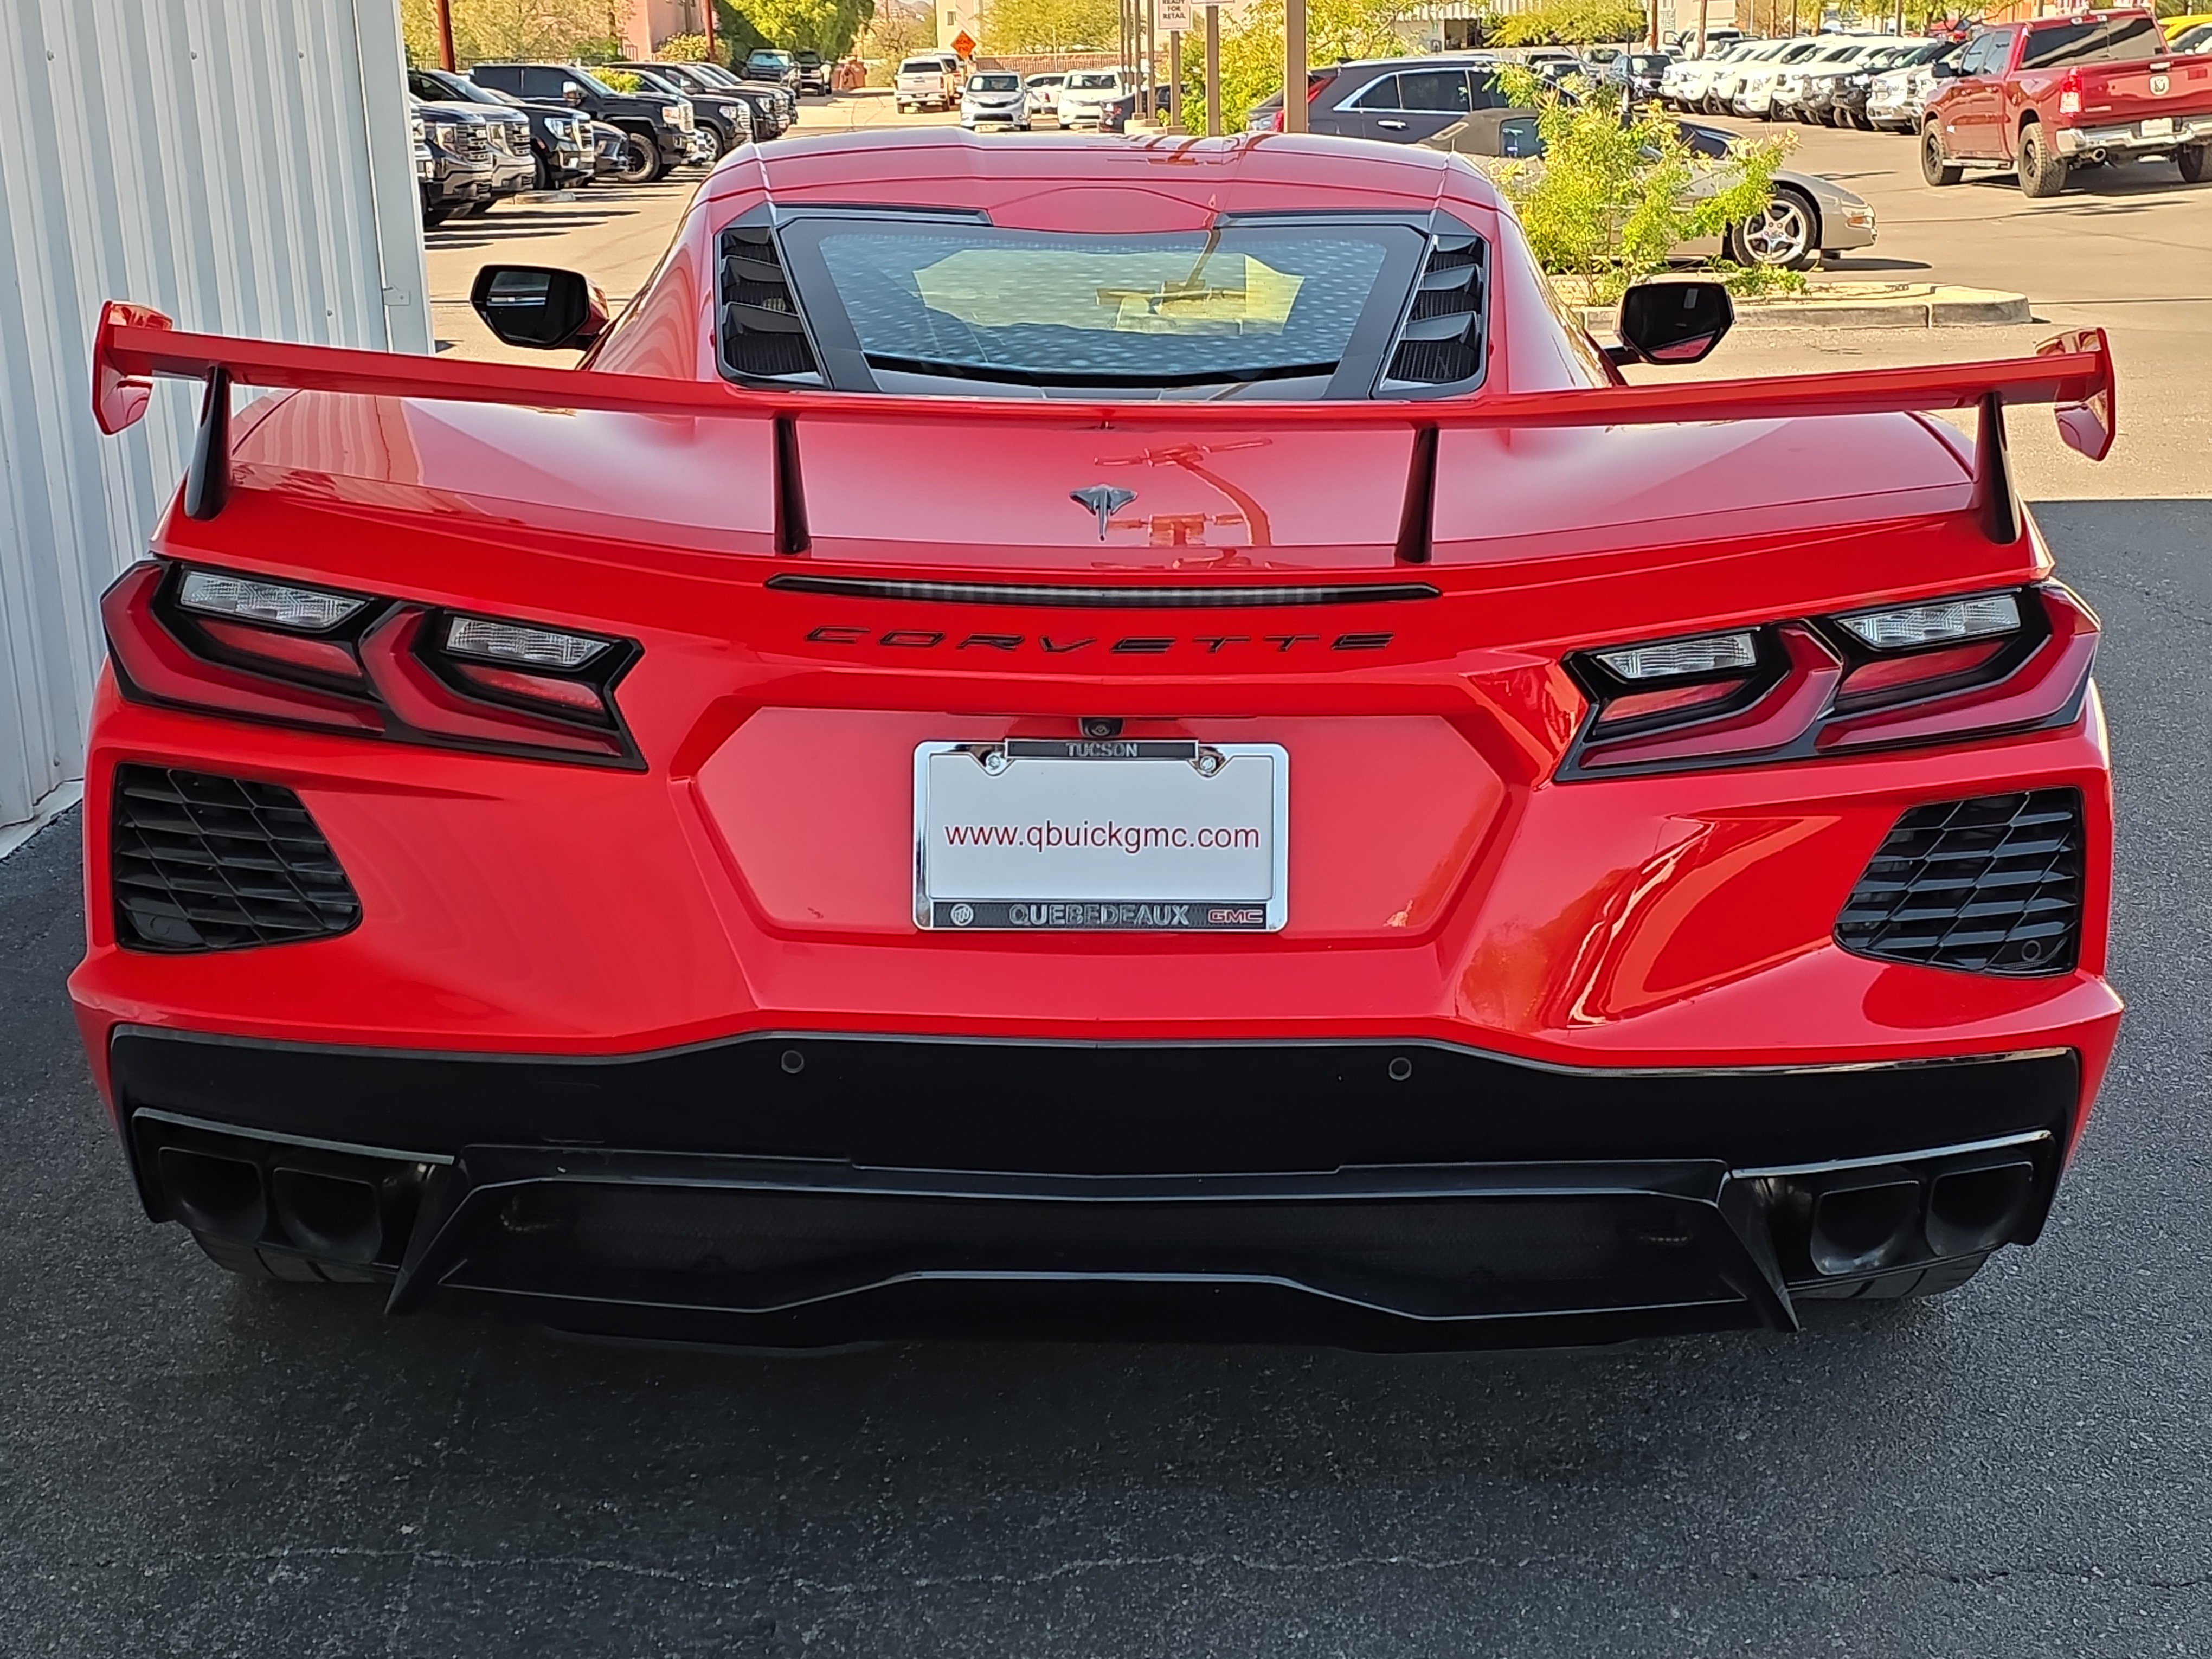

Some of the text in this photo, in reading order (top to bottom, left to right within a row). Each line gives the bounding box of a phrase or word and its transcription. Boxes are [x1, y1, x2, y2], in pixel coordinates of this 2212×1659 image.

[805, 626, 1396, 654] CORVETTE
[1065, 742, 1138, 757] TUCSON
[944, 820, 1259, 854] www.qbuickgmc.com
[1009, 904, 1263, 925] QUEBEDEAUX GMC
